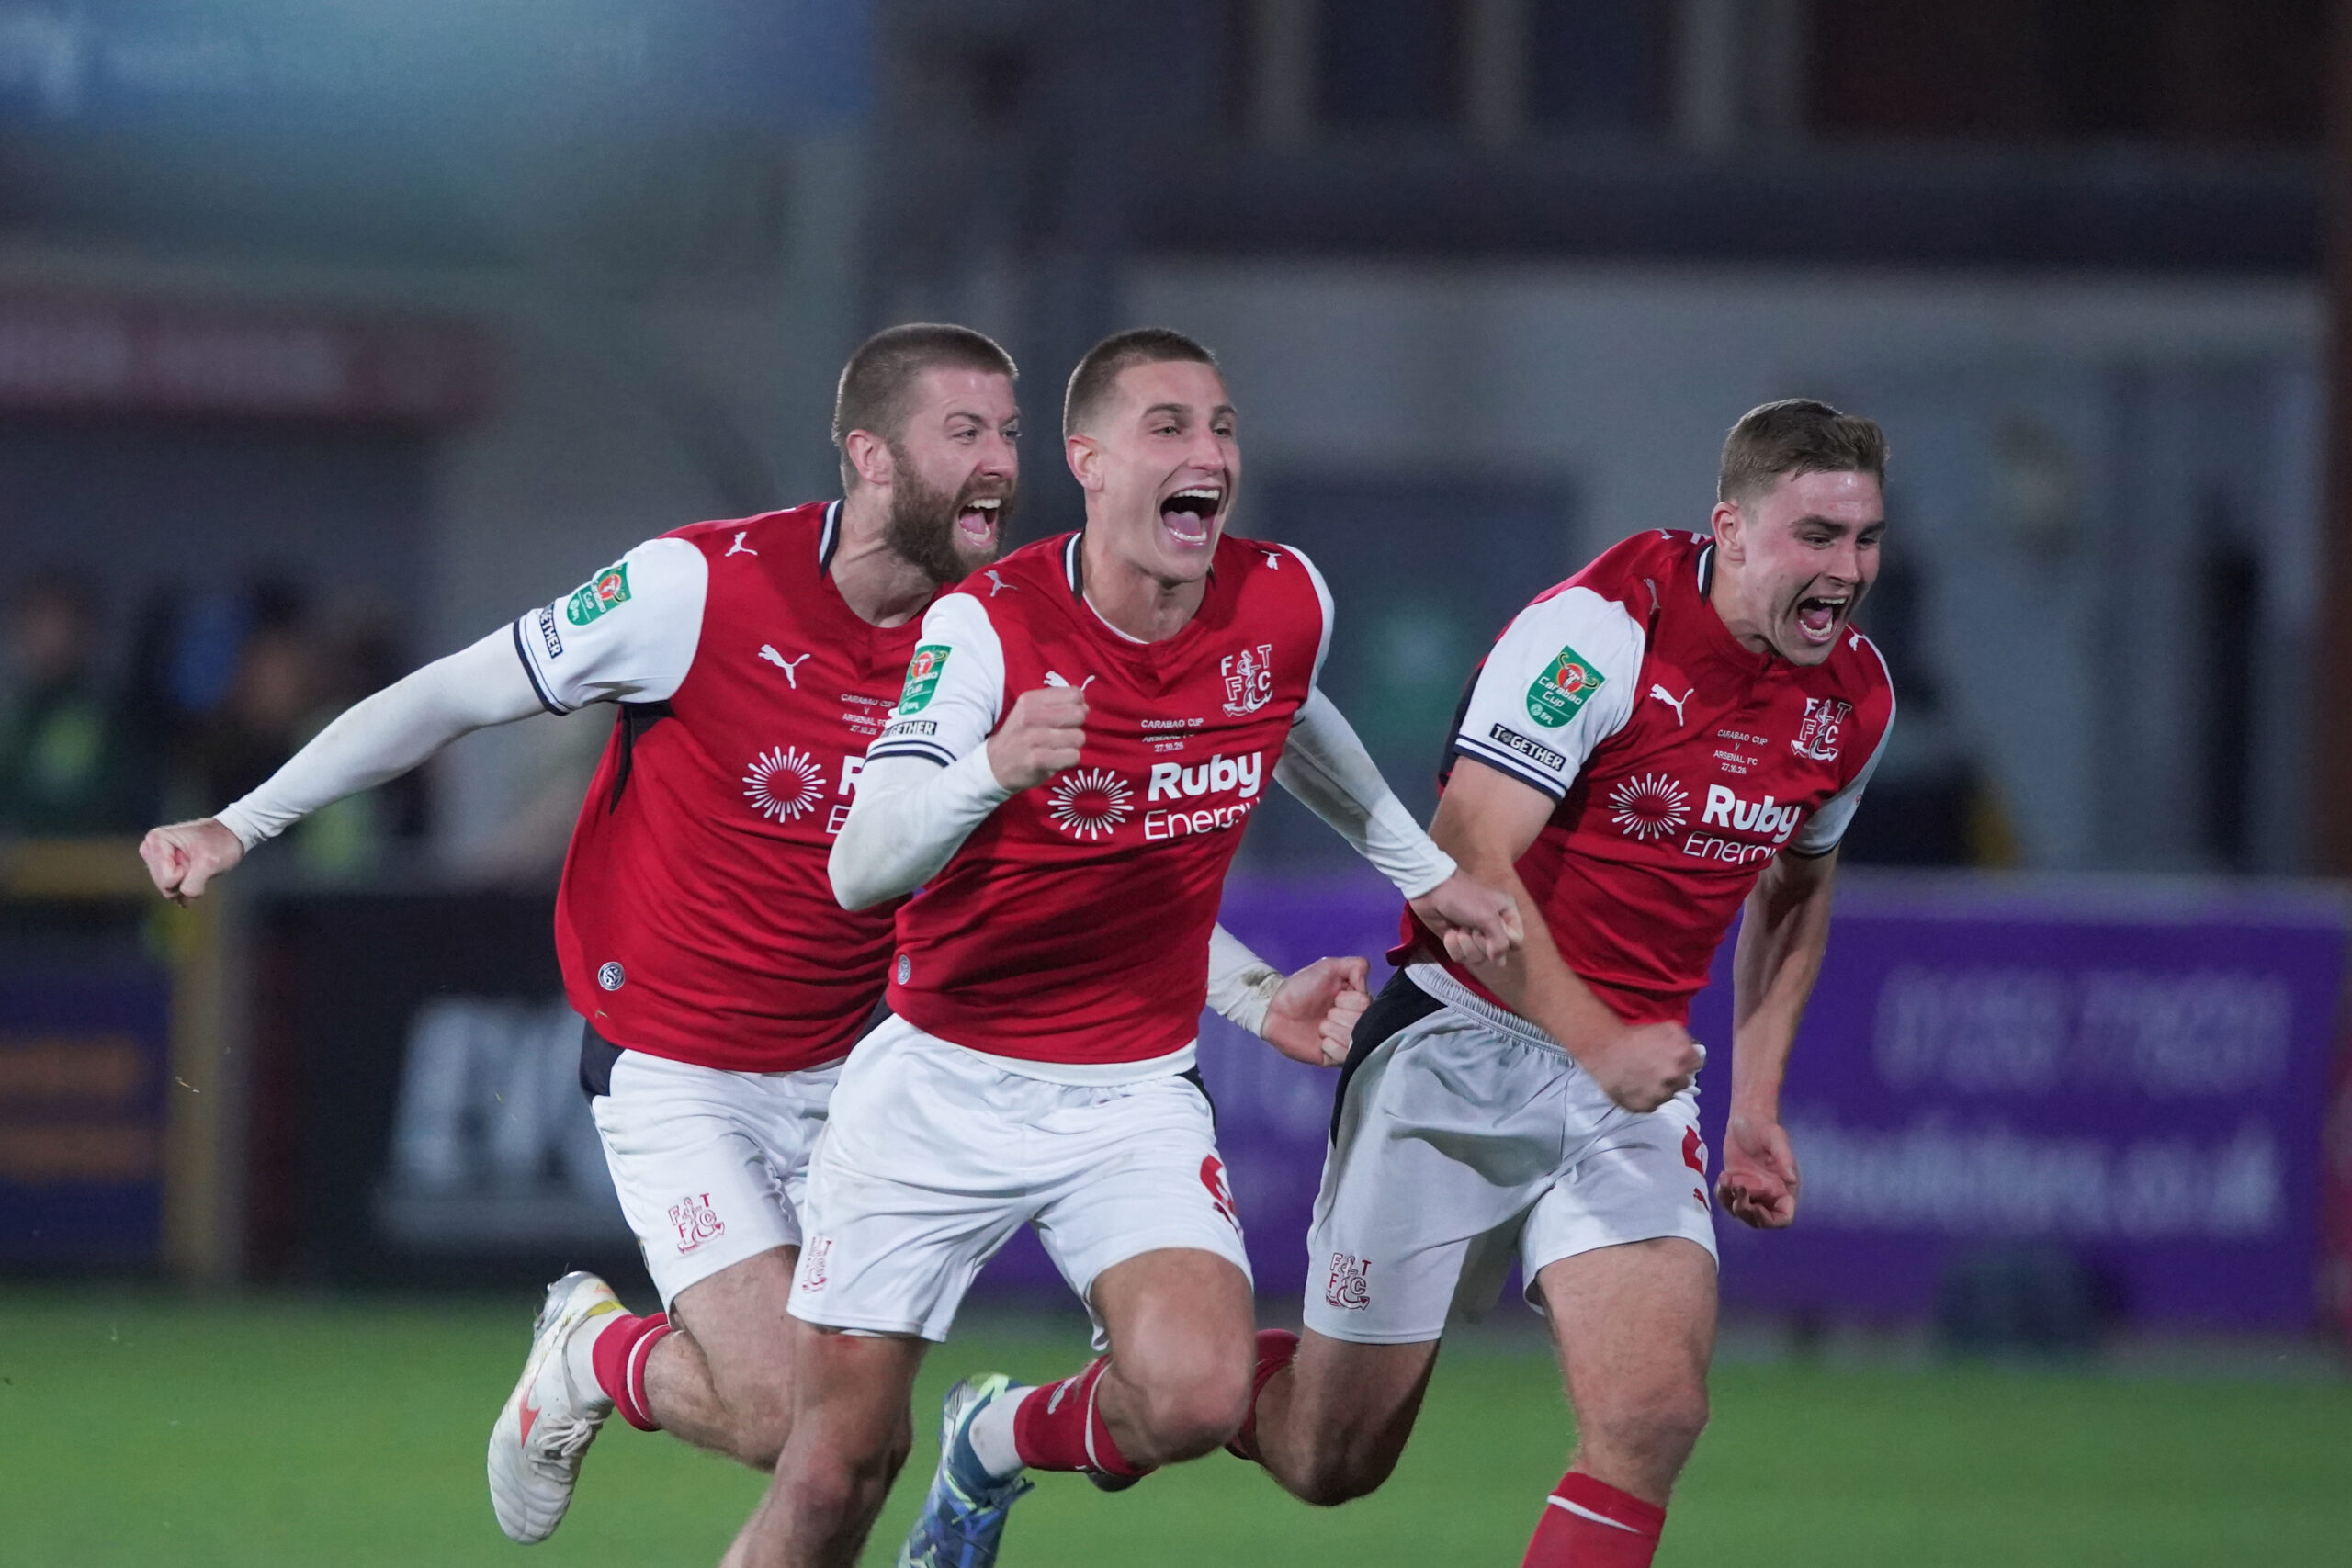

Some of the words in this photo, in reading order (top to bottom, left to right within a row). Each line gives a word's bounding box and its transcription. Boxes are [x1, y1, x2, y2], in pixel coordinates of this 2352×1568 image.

[1538, 676, 1583, 705] Carabao
[1542, 691, 1565, 707] Cup
[1141, 719, 1185, 728] CARABAO
[1187, 718, 1204, 727] CUP
[1717, 729, 1750, 741] CARABAO
[1751, 736, 1768, 745] CUP
[1713, 750, 1745, 763] ARSENAL
[1747, 757, 1758, 765] FC
[1148, 751, 1261, 802] Ruby
[1702, 784, 1802, 843] Ruby
